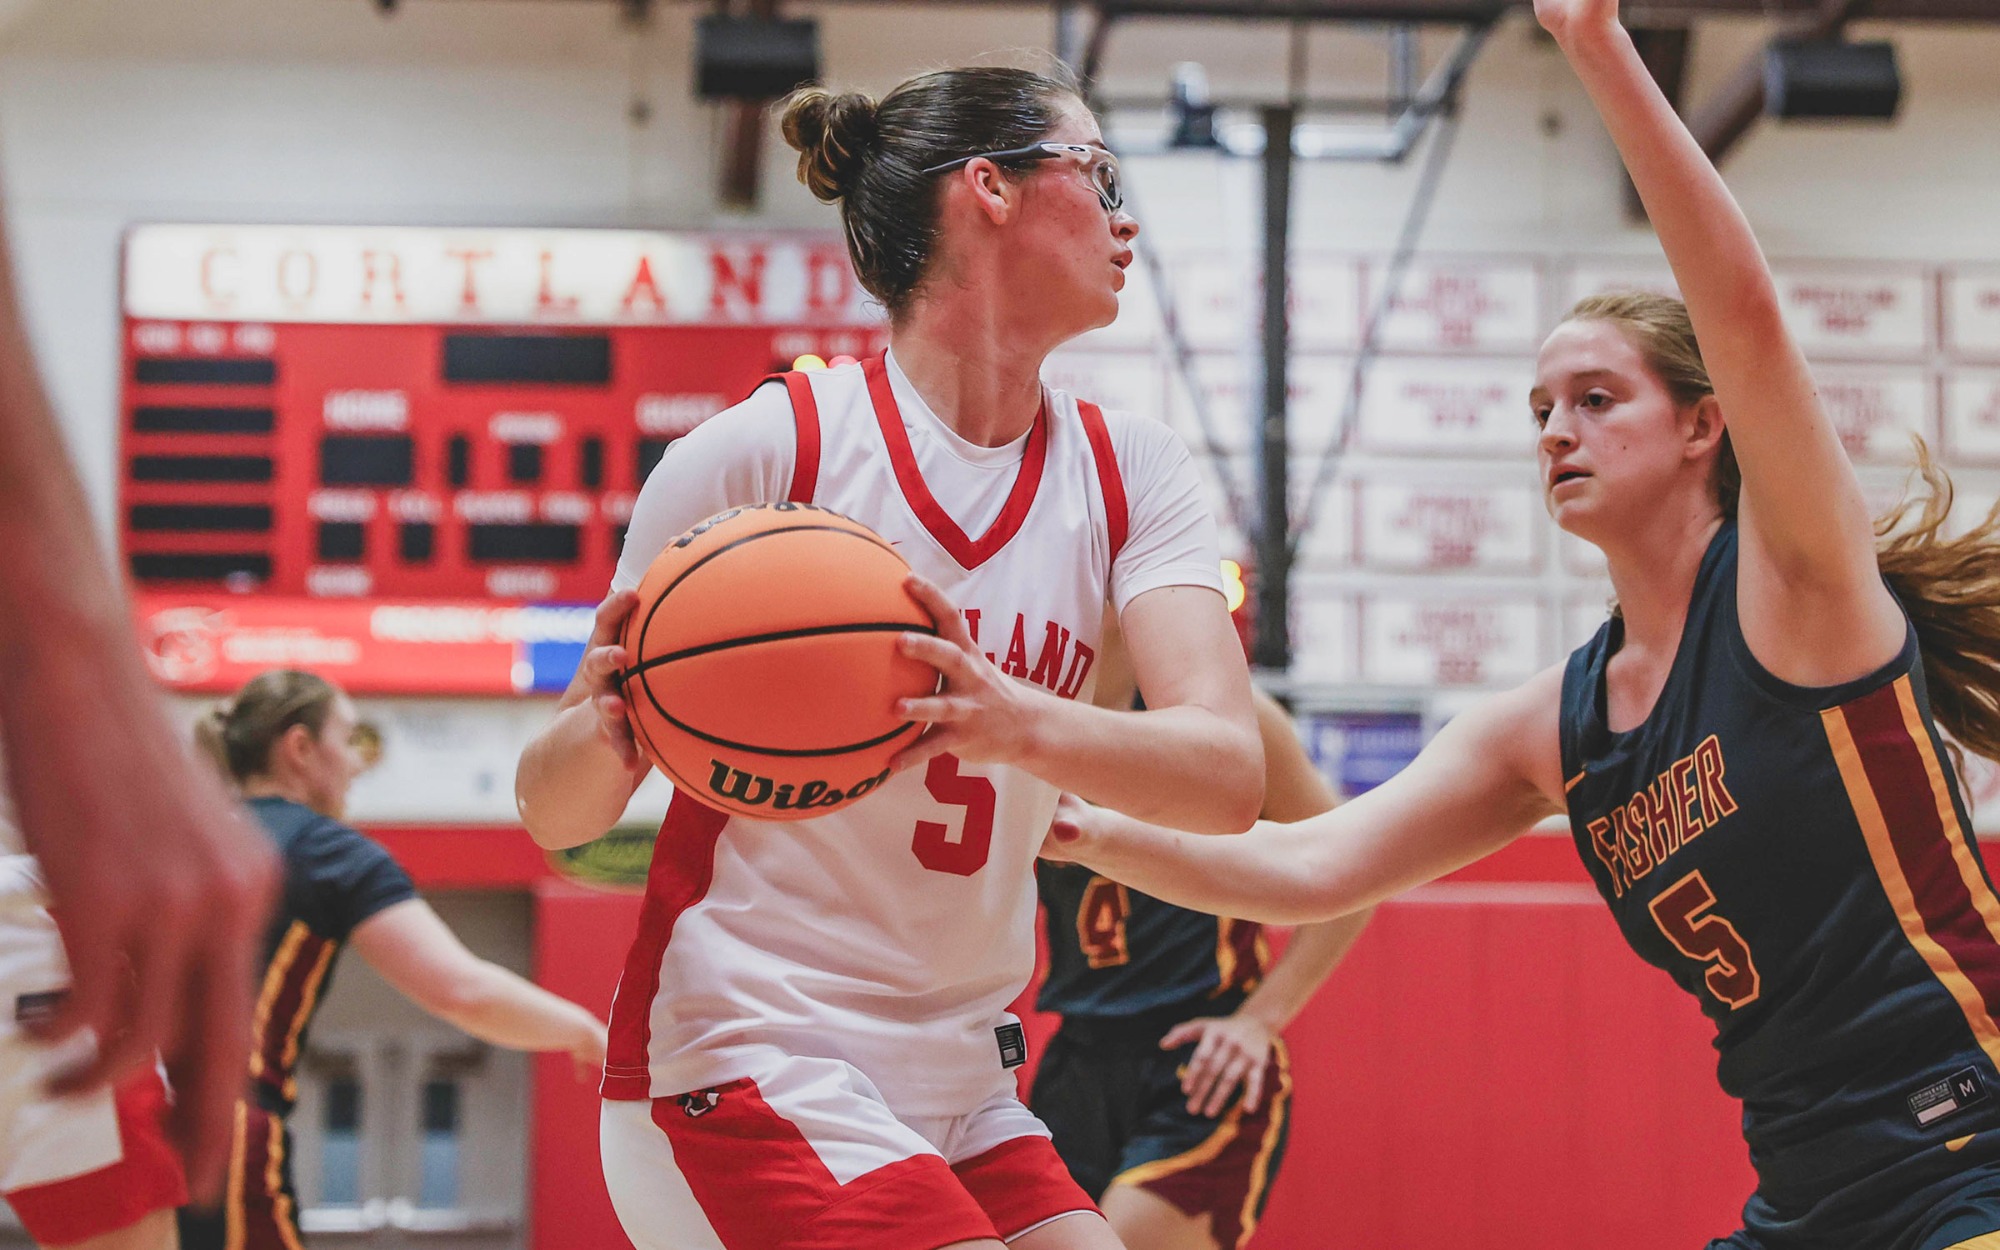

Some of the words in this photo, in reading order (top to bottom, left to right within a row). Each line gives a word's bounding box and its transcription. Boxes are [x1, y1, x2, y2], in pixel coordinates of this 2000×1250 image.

[200, 245, 853, 312] CORTLAND
[911, 752, 996, 876] 5
[1586, 733, 1739, 899] FISHER
[1076, 874, 1130, 969] 4
[1647, 868, 1761, 1011] 5
[1959, 1079, 1976, 1097] M
